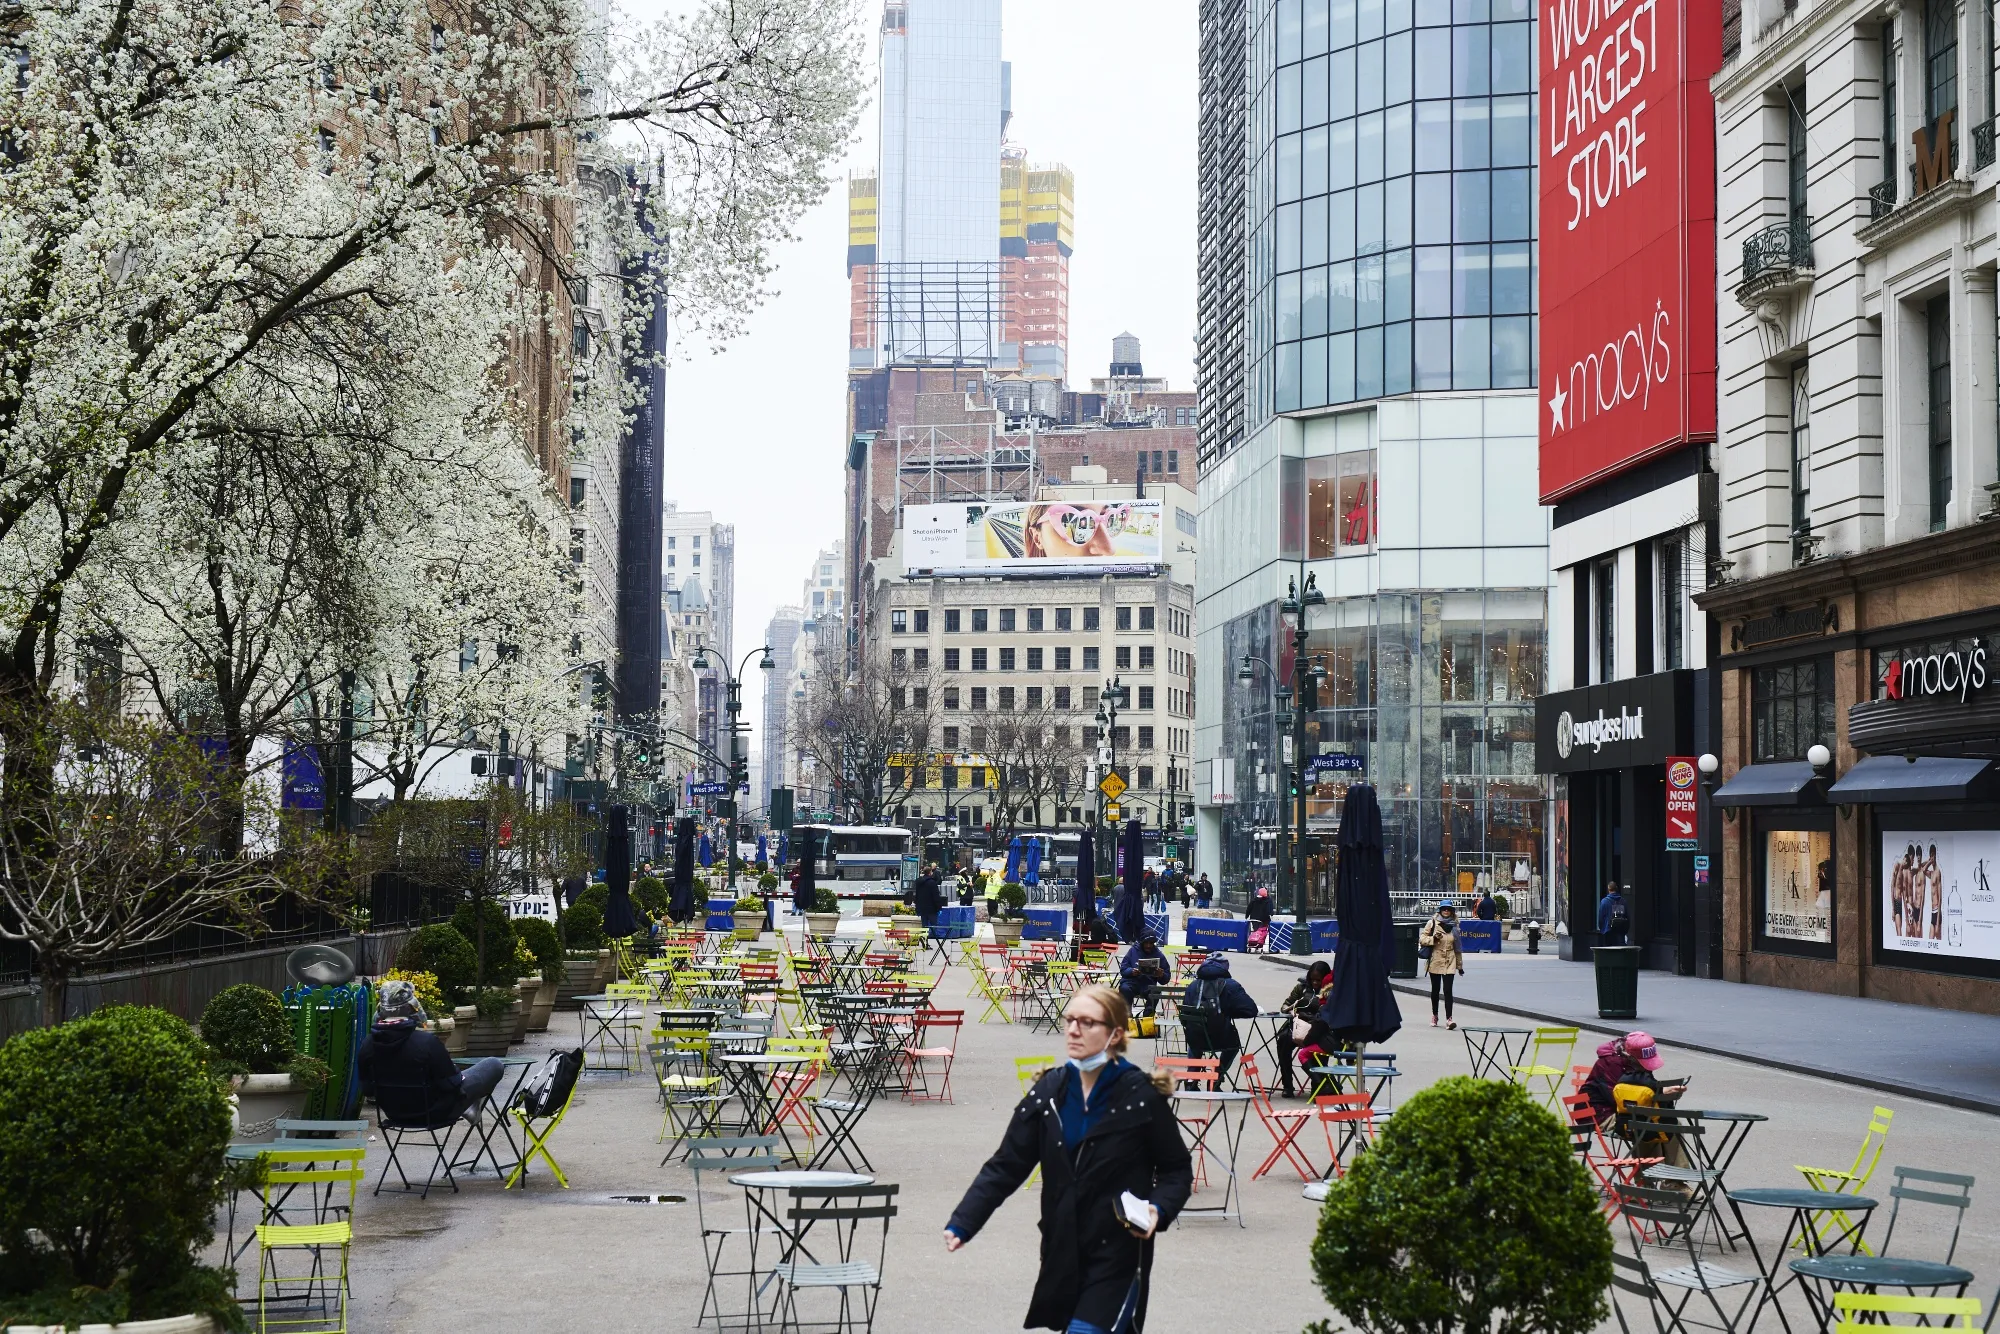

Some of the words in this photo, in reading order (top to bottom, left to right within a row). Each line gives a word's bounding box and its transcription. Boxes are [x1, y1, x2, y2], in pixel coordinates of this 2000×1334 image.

[1551, 0, 1657, 158] LARGEST
[1567, 99, 1647, 231] STORE
[1573, 708, 1622, 753] sunglass
[1621, 705, 1644, 740] hut
[1313, 758, 1333, 767] West
[1335, 758, 1350, 767] 34th
[1351, 758, 1360, 767] St
[1671, 766, 1692, 776] BURGER
[1672, 771, 1692, 782] KING
[707, 785, 718, 793] 34th
[1104, 784, 1123, 792] SLOW
[1669, 790, 1694, 801] NOW
[1667, 801, 1696, 812] OPEN
[1777, 840, 1794, 853] CALVIN
[1032, 919, 1053, 927] Square
[1808, 916, 1817, 929] OF
[1195, 928, 1216, 936] Herald
[1216, 929, 1238, 938] Square
[1469, 931, 1491, 939] Square
